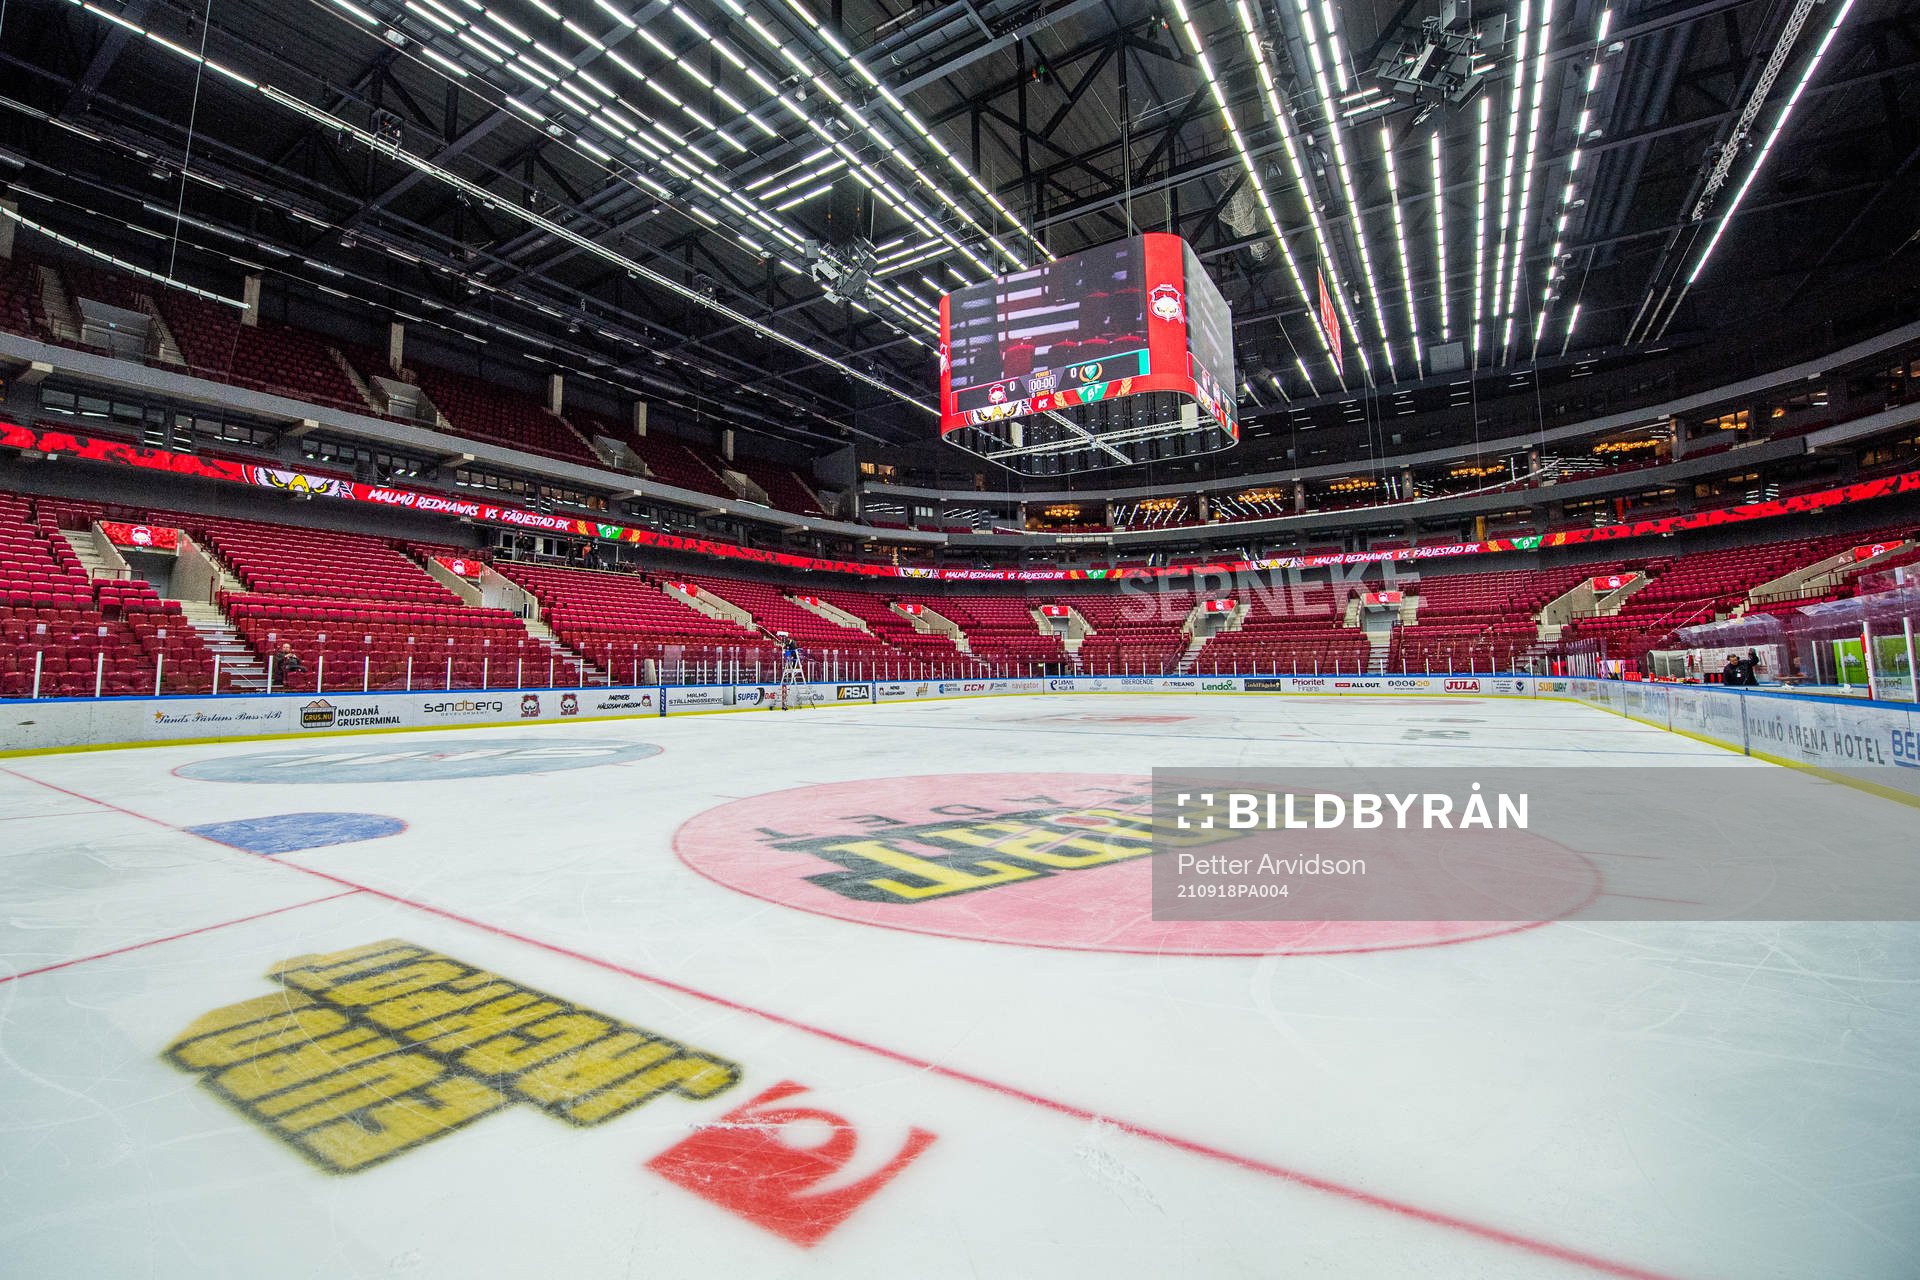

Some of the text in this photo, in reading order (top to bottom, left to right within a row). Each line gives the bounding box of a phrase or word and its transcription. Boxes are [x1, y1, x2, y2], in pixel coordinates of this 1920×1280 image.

[1070, 367, 1077, 378] 0
[1009, 381, 1016, 391] 0
[1030, 377, 1054, 391] 00:00
[1038, 399, 1048, 408] VS
[368, 489, 571, 531] MALMÖ REDHAWKS VS FÄRJESTAD BK
[1313, 544, 1480, 565] MALMÖ REDHAWKS VS FÄRJESTAD BK
[945, 570, 968, 579] MALMÖ
[969, 571, 1004, 579] REDHAWKS
[1017, 571, 1054, 579] FÄRJESTAD
[963, 683, 985, 692] CCM
[1011, 682, 1039, 690] navigator
[1202, 682, 1229, 691] Lendo
[1292, 678, 1325, 686] Prioritet
[1446, 680, 1479, 691] JULA
[1538, 682, 1567, 693] SUBWAY
[737, 692, 758, 701] SUPER
[844, 687, 868, 699] RSA
[337, 705, 379, 717] NORDANÅ
[424, 700, 503, 713] sandberg
[304, 713, 332, 721] GRUS.NU
[337, 716, 401, 727] GRUSTERMINAL
[1750, 715, 1885, 765] MALMÖ ARENA HOTEL
